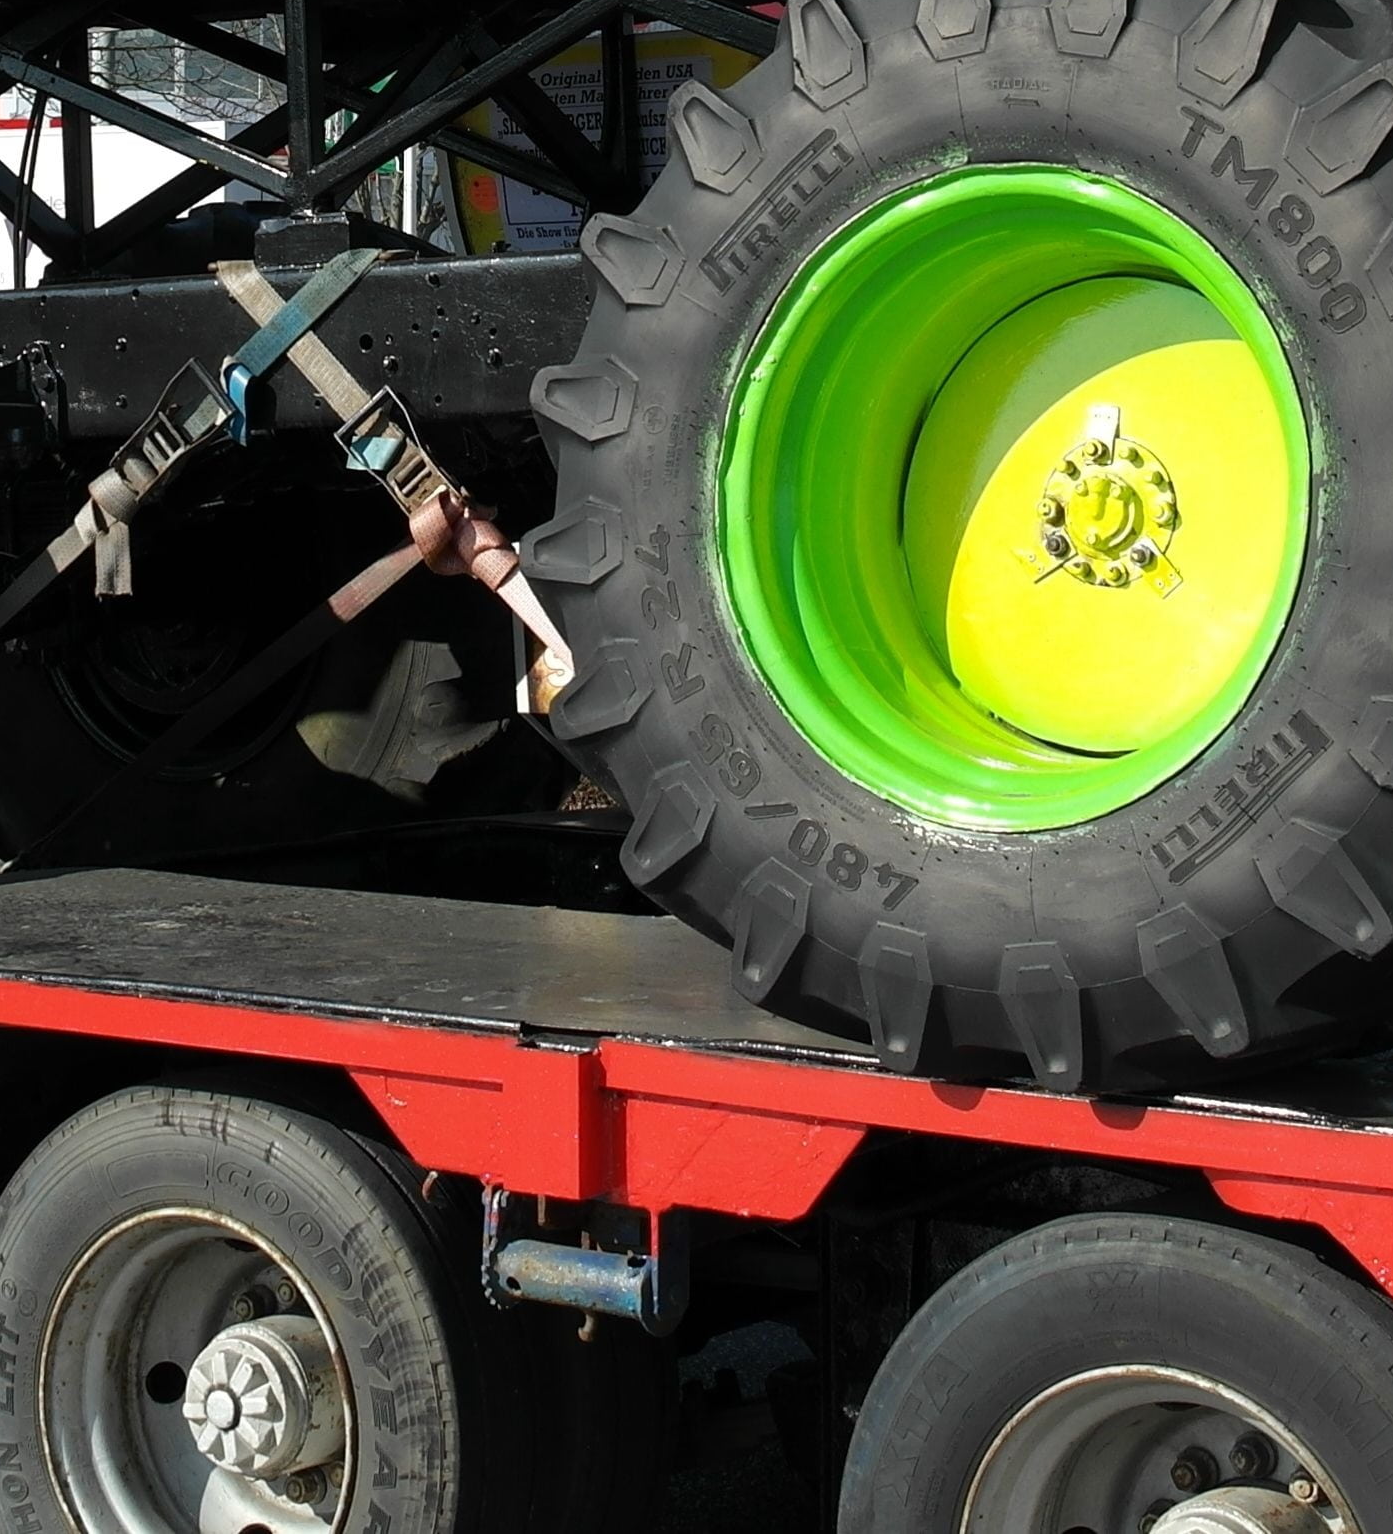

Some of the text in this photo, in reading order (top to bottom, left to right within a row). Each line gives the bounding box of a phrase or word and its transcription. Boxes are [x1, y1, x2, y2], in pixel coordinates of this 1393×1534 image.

[541, 69, 602, 88] Original
[666, 63, 694, 79] USA
[990, 77, 1051, 91] RADIAL
[698, 128, 854, 297] PIRELLI
[516, 227, 535, 239] Die
[536, 225, 562, 238] Show
[1151, 709, 1334, 886] PIRELLI
